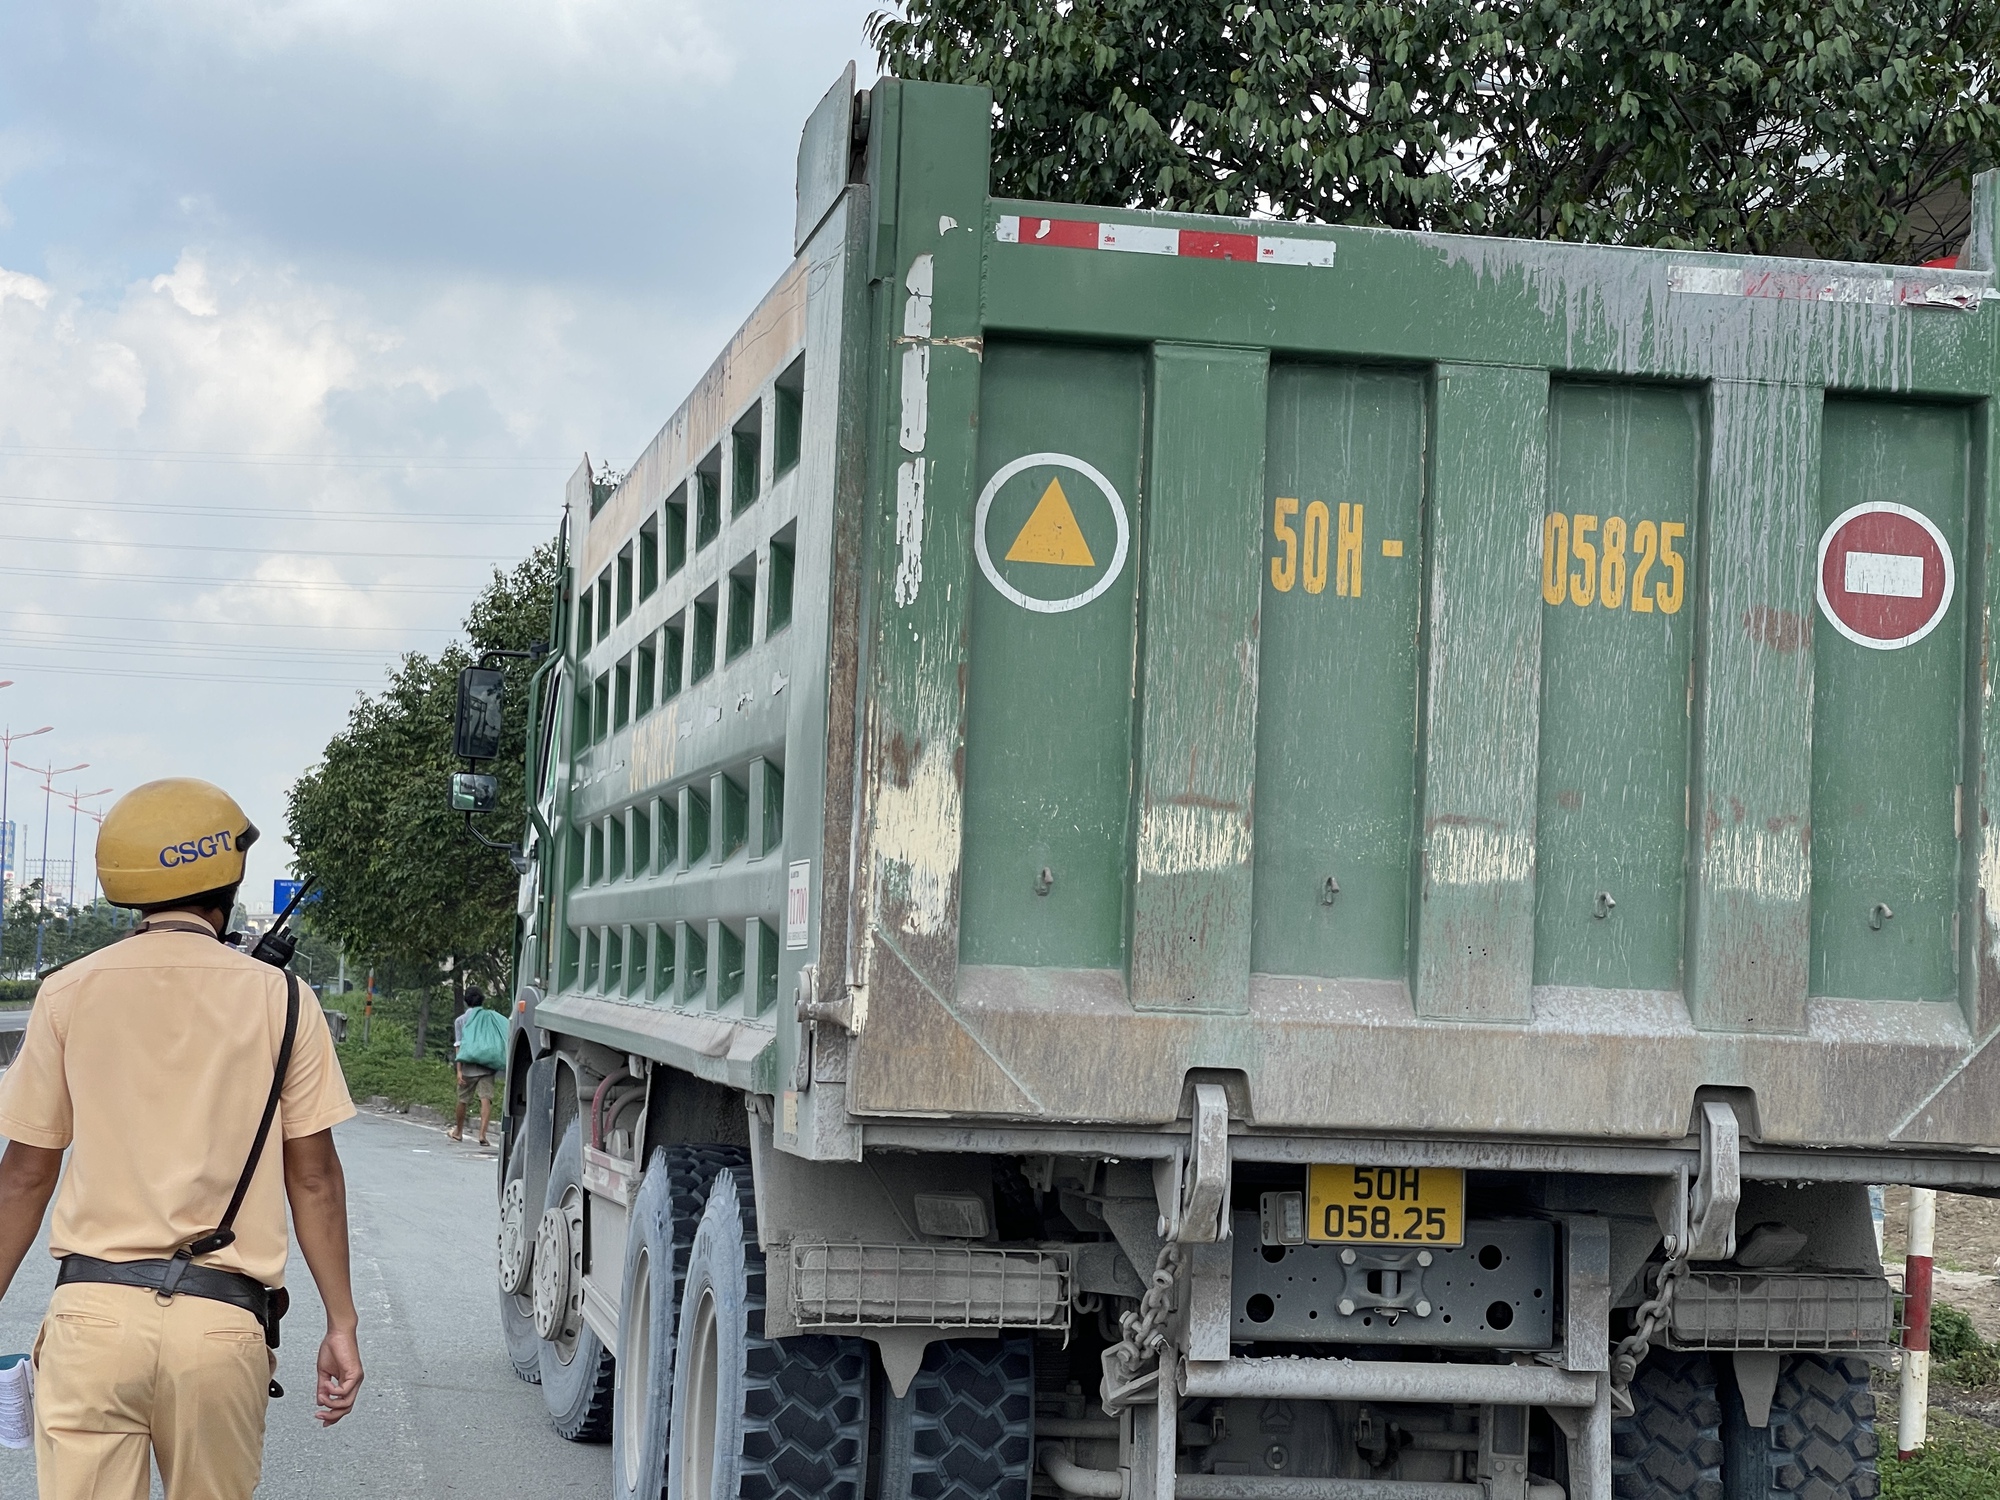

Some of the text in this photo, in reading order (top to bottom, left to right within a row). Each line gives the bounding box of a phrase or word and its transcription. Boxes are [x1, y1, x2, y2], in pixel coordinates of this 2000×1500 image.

[1104, 235, 1116, 243] 3M
[1262, 248, 1274, 256] 3M
[1542, 511, 1686, 614] 05825
[158, 830, 233, 869] CSGT
[1353, 1167, 1420, 1201] 50H
[1324, 1204, 1447, 1241] 058.25
